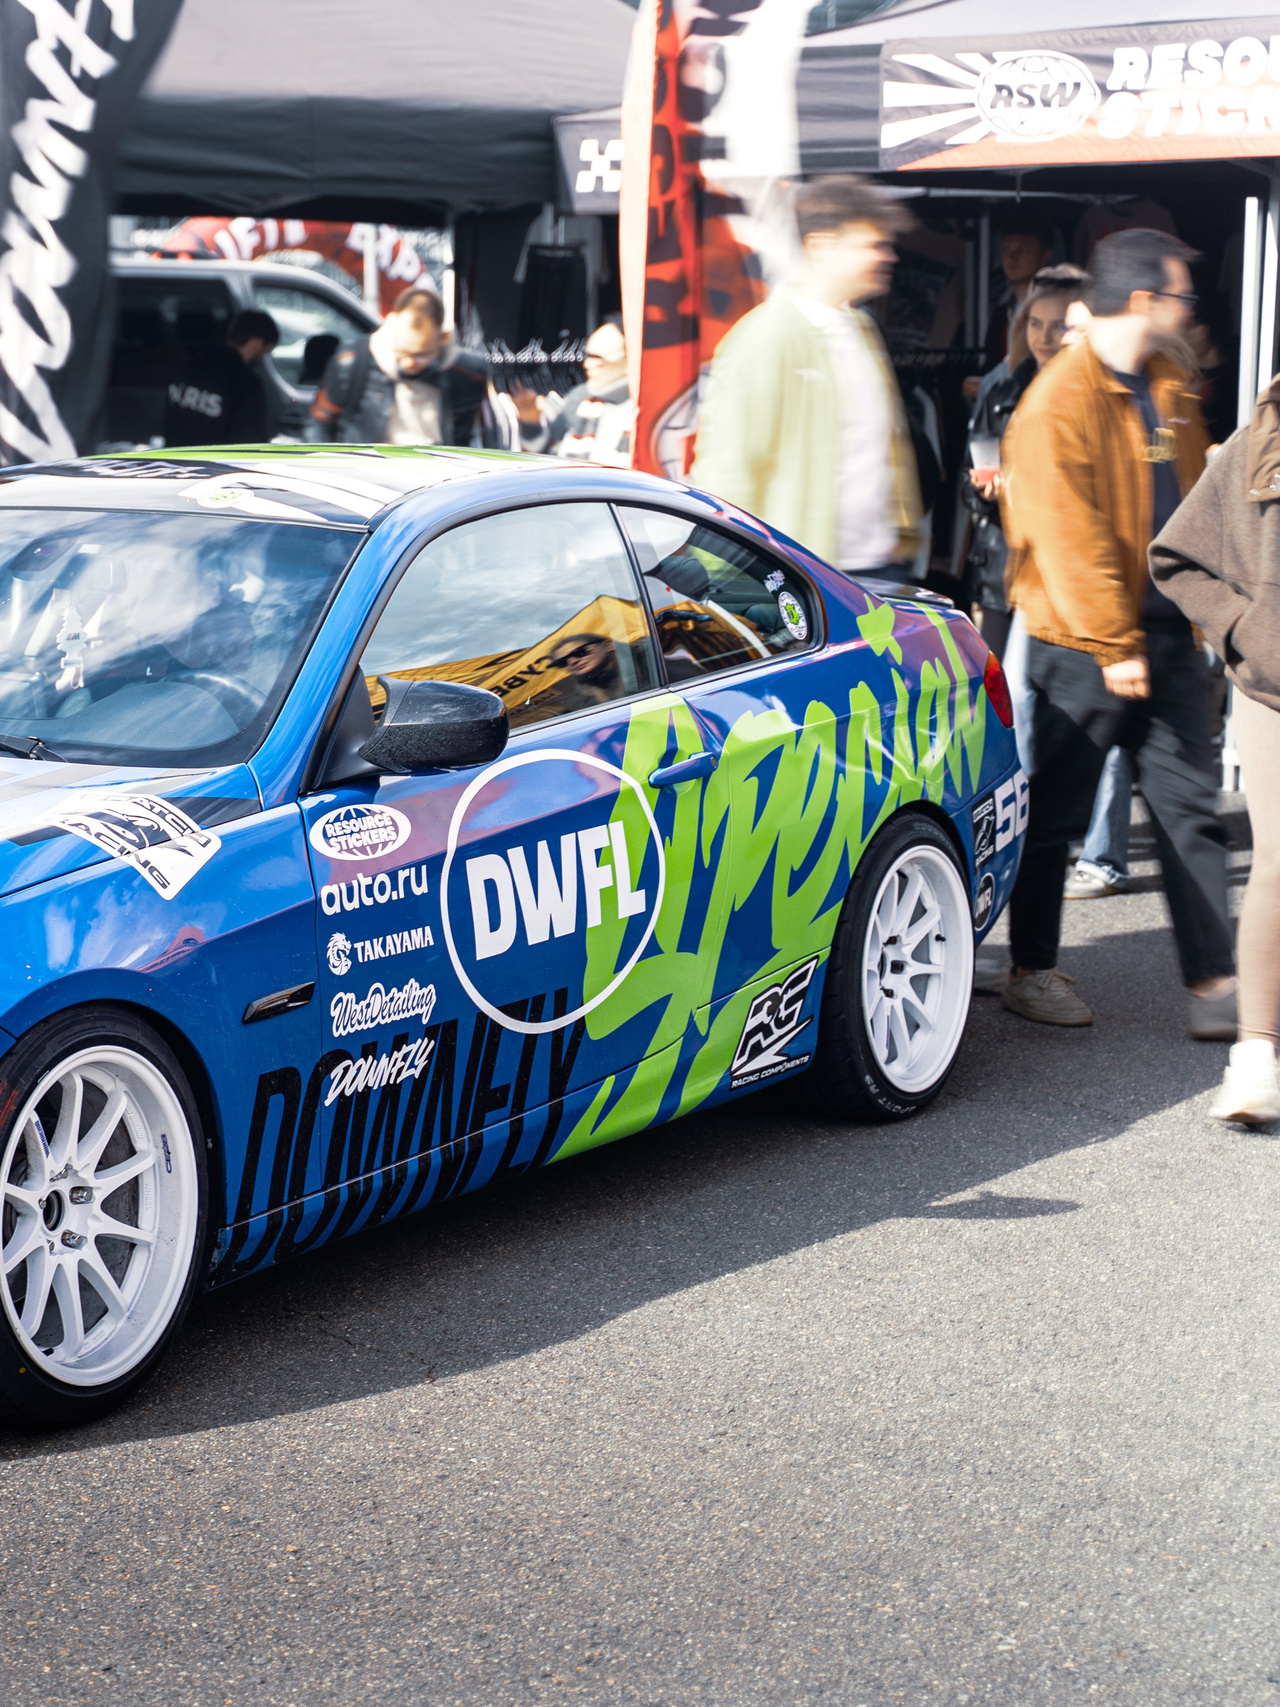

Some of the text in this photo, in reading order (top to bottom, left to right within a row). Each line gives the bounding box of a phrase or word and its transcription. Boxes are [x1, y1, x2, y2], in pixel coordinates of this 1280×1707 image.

[1106, 35, 1280, 91] RESO
[989, 82, 1081, 109] RSW
[325, 811, 393, 837] RESOURCE
[995, 769, 1030, 852] 56
[328, 826, 397, 852] STICKERS
[320, 864, 428, 916] auto.ru
[466, 820, 646, 961] DWFL
[354, 925, 435, 963] TAKAYAMA
[324, 1037, 435, 1107] DOWNFLY
[731, 1054, 811, 1089] RACING COMPONENTS
[223, 988, 588, 1277] DOWNFLY
